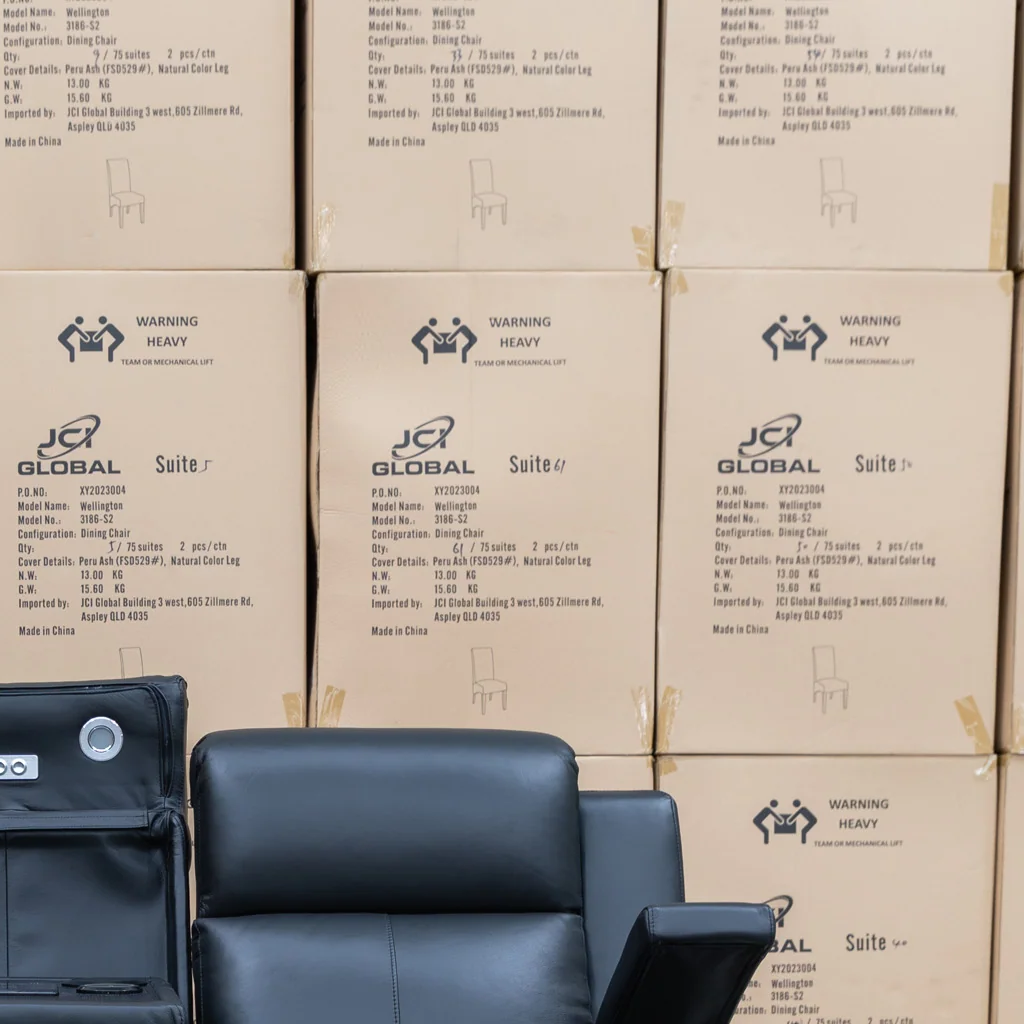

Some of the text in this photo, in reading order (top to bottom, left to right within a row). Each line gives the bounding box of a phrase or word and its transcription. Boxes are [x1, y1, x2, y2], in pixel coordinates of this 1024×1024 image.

[3, 8, 27, 18] Model
[66, 8, 110, 19] Wellington
[368, 136, 425, 147] Made in China
[136, 316, 198, 327] WARNING
[489, 317, 551, 328] WARNING
[840, 316, 901, 326] WARNING
[147, 336, 187, 347] HEAVY
[500, 337, 540, 348] HEAVY
[850, 336, 889, 346] HEAVY
[18, 460, 121, 475] GLOBAL
[156, 455, 197, 473] Suite
[372, 460, 475, 476] GLOBAL
[509, 455, 550, 473] Suite
[717, 459, 820, 474] GLOBAL
[855, 454, 896, 473] Suite
[80, 485, 126, 495] XY2023004
[779, 484, 825, 495] XY2023004
[18, 501, 42, 511] Model
[80, 501, 123, 512] Wellington
[435, 570, 457, 580] 13.00
[466, 570, 476, 580] KG
[434, 584, 457, 594] 15.60
[468, 584, 478, 594] KG
[372, 626, 428, 636] Made in China
[713, 624, 769, 634] Made in China
[829, 799, 889, 809] WARNING
[839, 819, 878, 829] HEAVY
[846, 933, 886, 952] Suite
[771, 963, 816, 973] XY2023004
[771, 979, 813, 990] Wellington
[771, 991, 804, 1001] 3186-S2
[771, 1004, 820, 1016] Dining Chair
